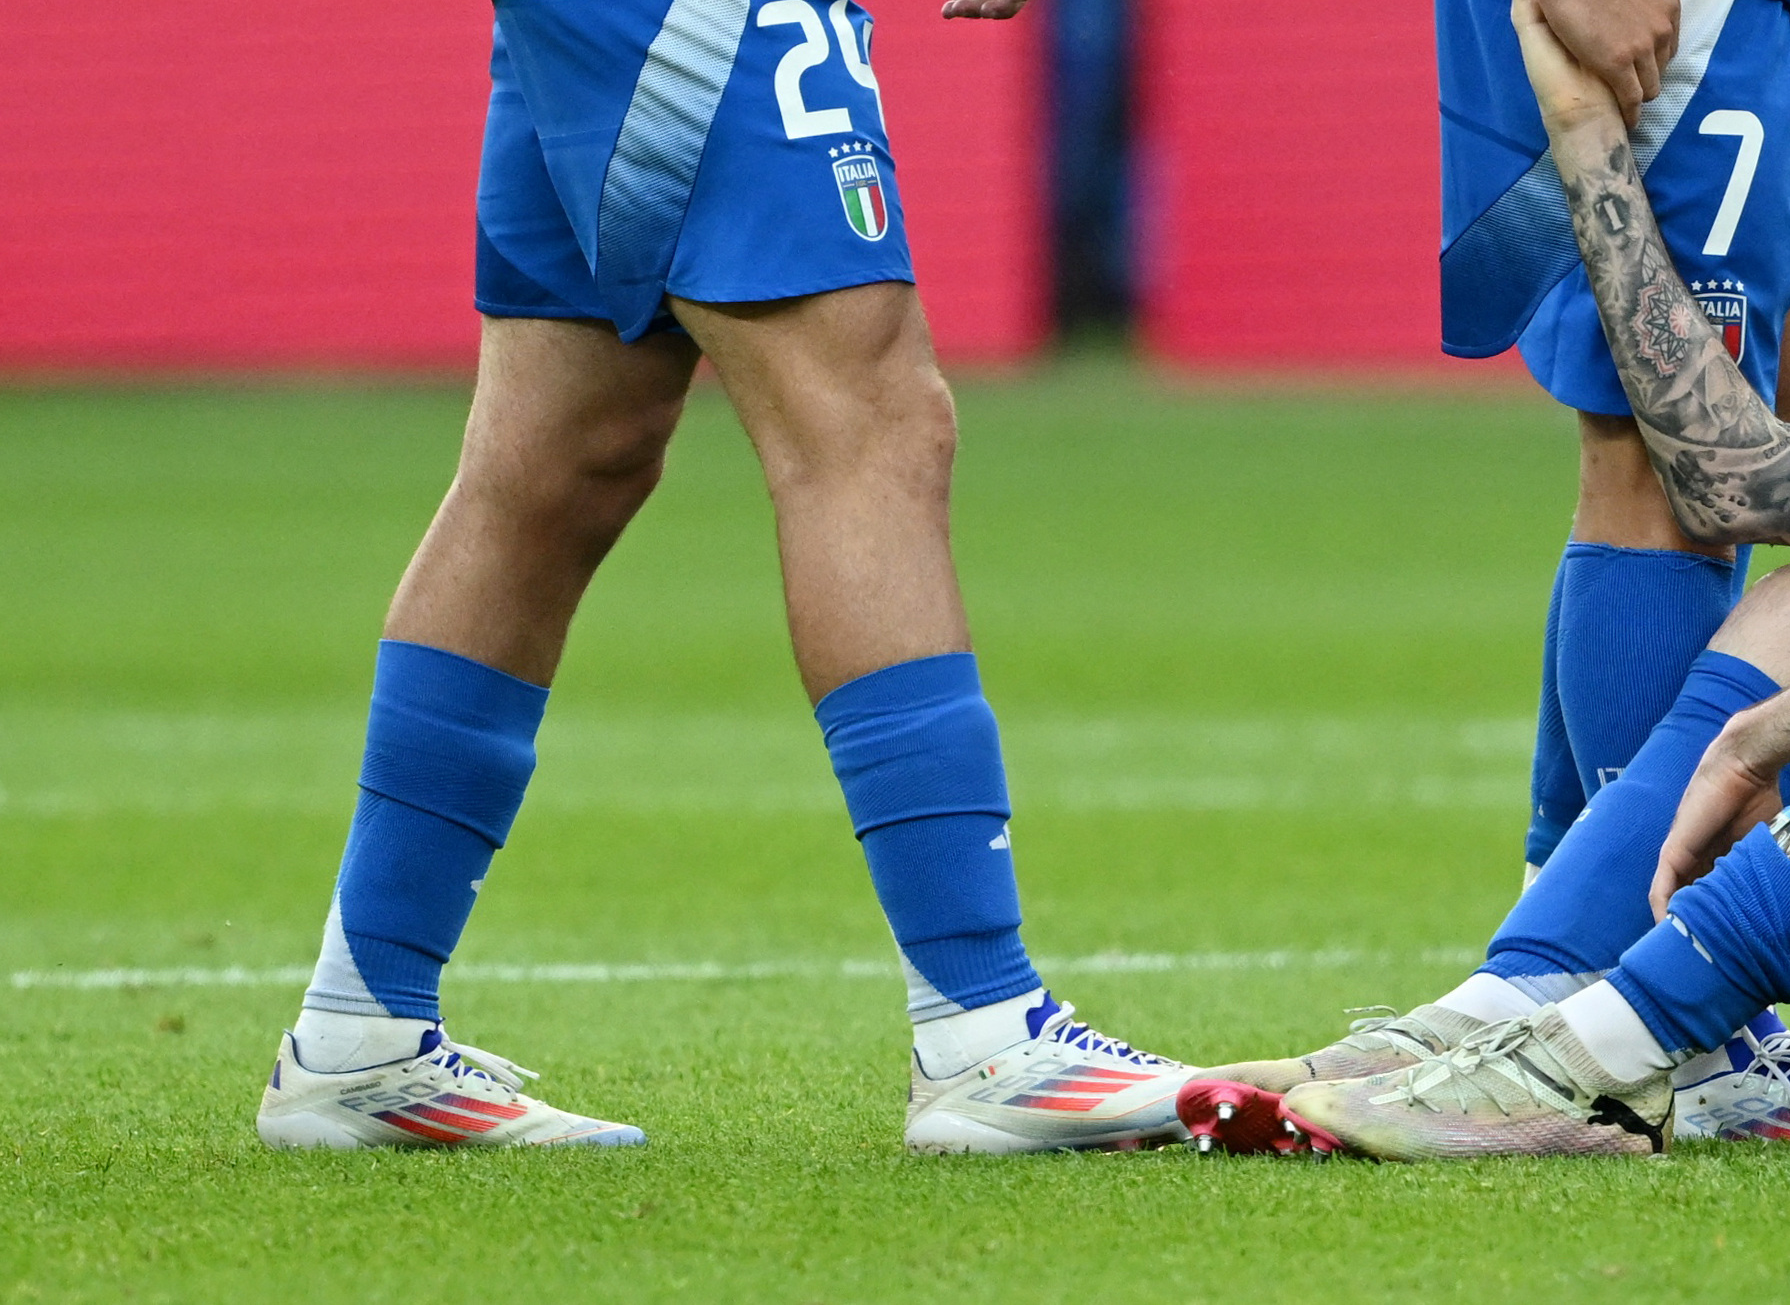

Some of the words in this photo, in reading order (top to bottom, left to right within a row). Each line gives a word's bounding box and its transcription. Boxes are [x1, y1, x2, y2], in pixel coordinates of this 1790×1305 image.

[837, 162, 877, 183] ITALIA
[1698, 109, 1765, 257] 7
[1698, 300, 1741, 317] TALIA
[338, 1082, 441, 1112] F50
[1684, 1097, 1774, 1131] F50
